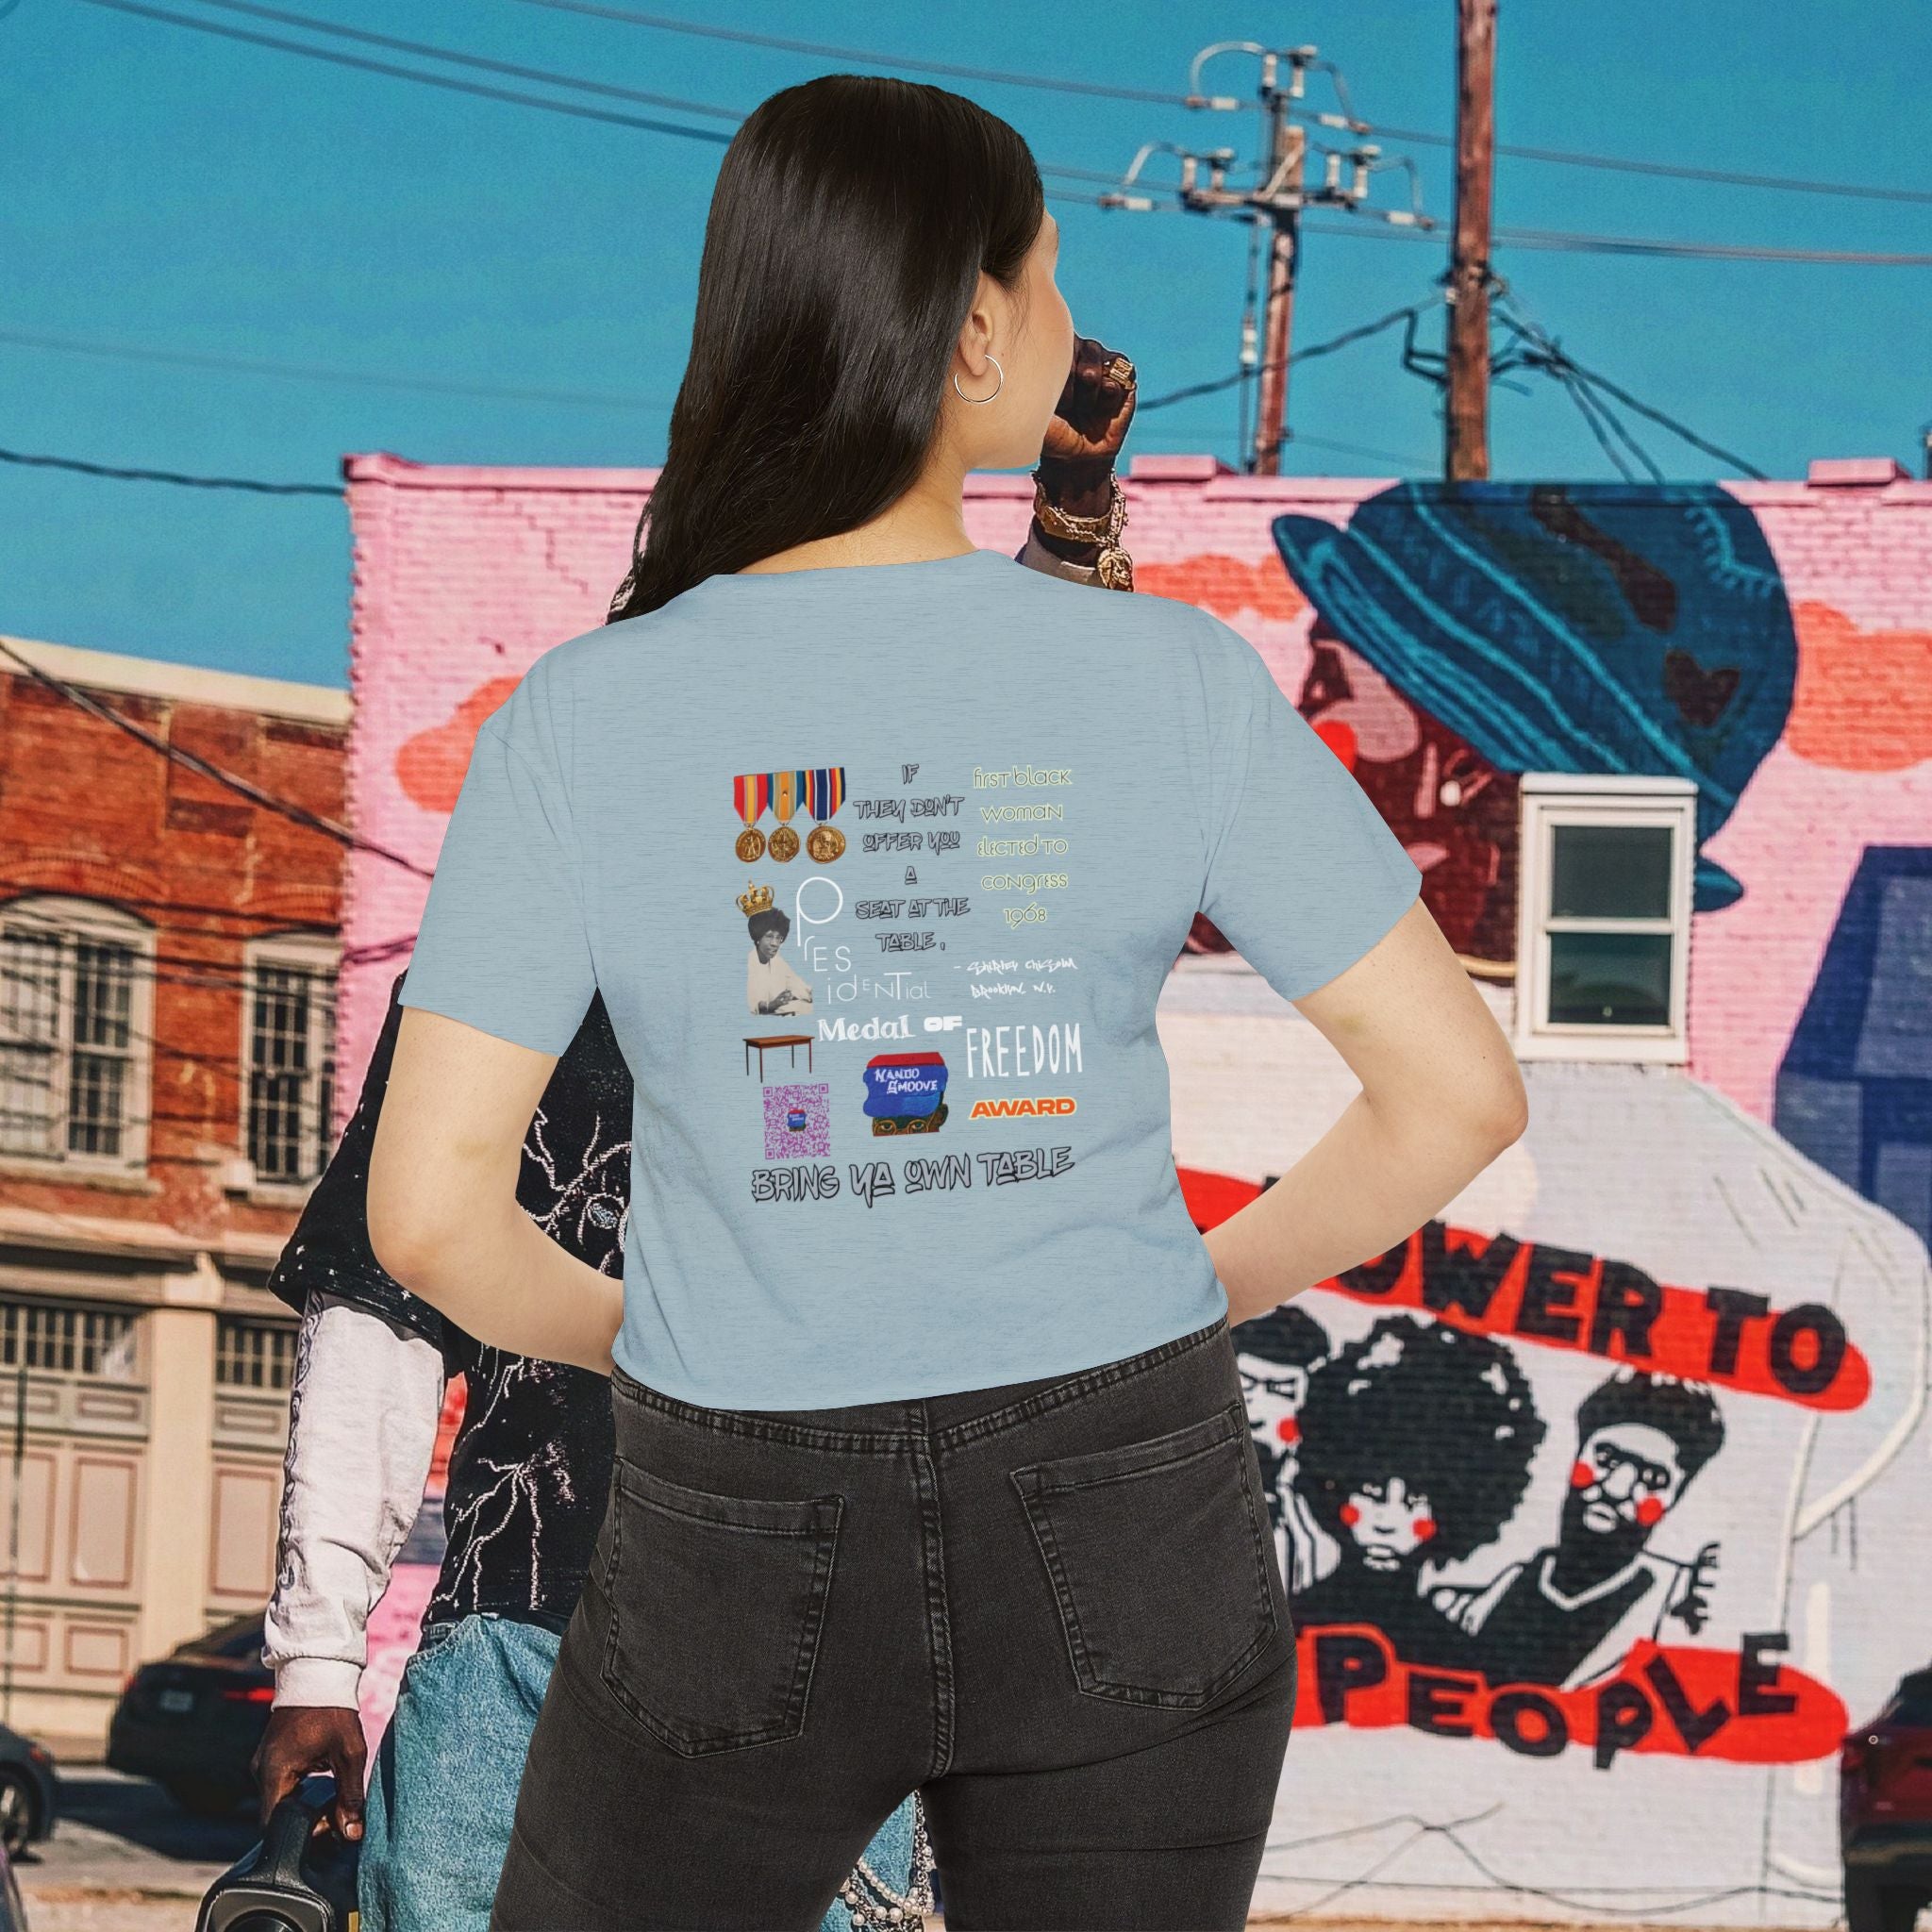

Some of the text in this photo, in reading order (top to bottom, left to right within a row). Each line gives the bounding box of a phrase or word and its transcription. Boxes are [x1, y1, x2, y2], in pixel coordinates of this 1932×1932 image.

[901, 764, 919, 784] IF
[853, 799, 906, 823] THEY
[863, 830, 960, 856] OFFER YOU
[905, 865, 918, 885] A
[855, 896, 971, 919] SEAT AT THE
[1005, 903, 1048, 929] 1968
[817, 1015, 962, 1042] Medal OF
[966, 1023, 1083, 1078] FREEDOM
[968, 1096, 1077, 1121] AWARD
[752, 1145, 1075, 1208] BRING YA OWN TABLE
[1706, 1285, 1847, 1394] TO
[1314, 1633, 1798, 1770] PEOPLE
